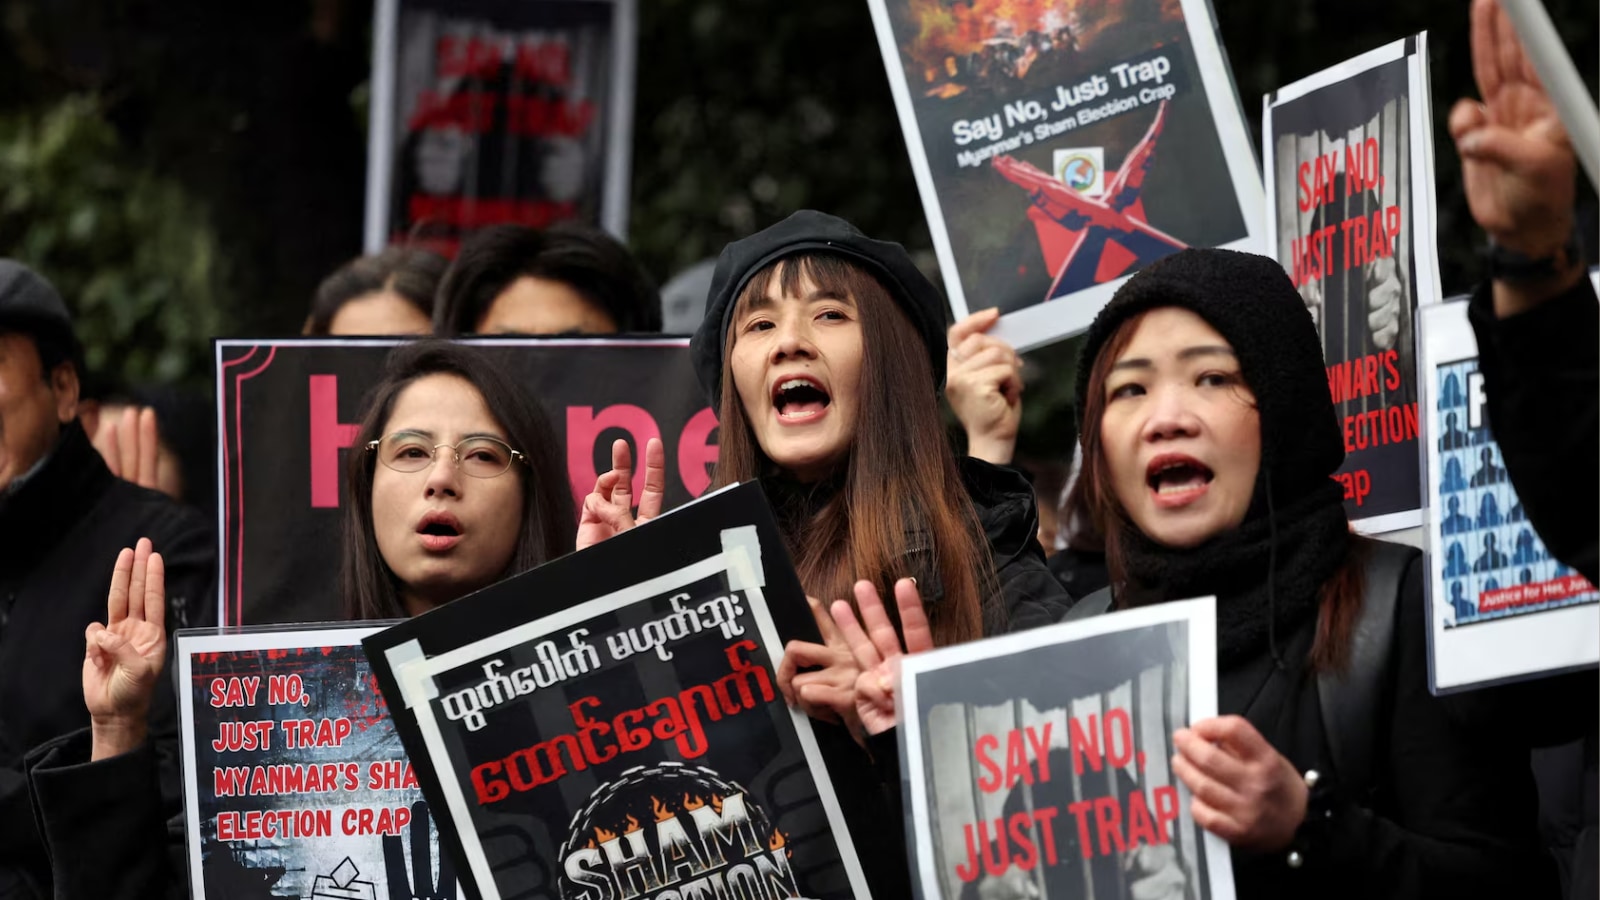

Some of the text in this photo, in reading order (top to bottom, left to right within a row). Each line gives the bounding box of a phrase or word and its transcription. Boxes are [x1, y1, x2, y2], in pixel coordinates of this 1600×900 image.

[952, 55, 1171, 145] Say No, Just Trap
[956, 83, 1176, 168] Myanmar's Sham Election Crap
[1297, 137, 1385, 213] SAY NO,
[1289, 205, 1401, 289] JUST TRAP
[1343, 402, 1420, 453] ECTION
[210, 673, 310, 708] SAY NO,
[212, 717, 351, 752] JUST TRAP
[974, 707, 1146, 794] SAY NO,
[214, 760, 421, 797] MYANMAR'S SHA
[217, 807, 411, 841] ELECTION CRAP
[564, 792, 764, 900] SHAM
[956, 785, 1179, 883] JUST TRAP
